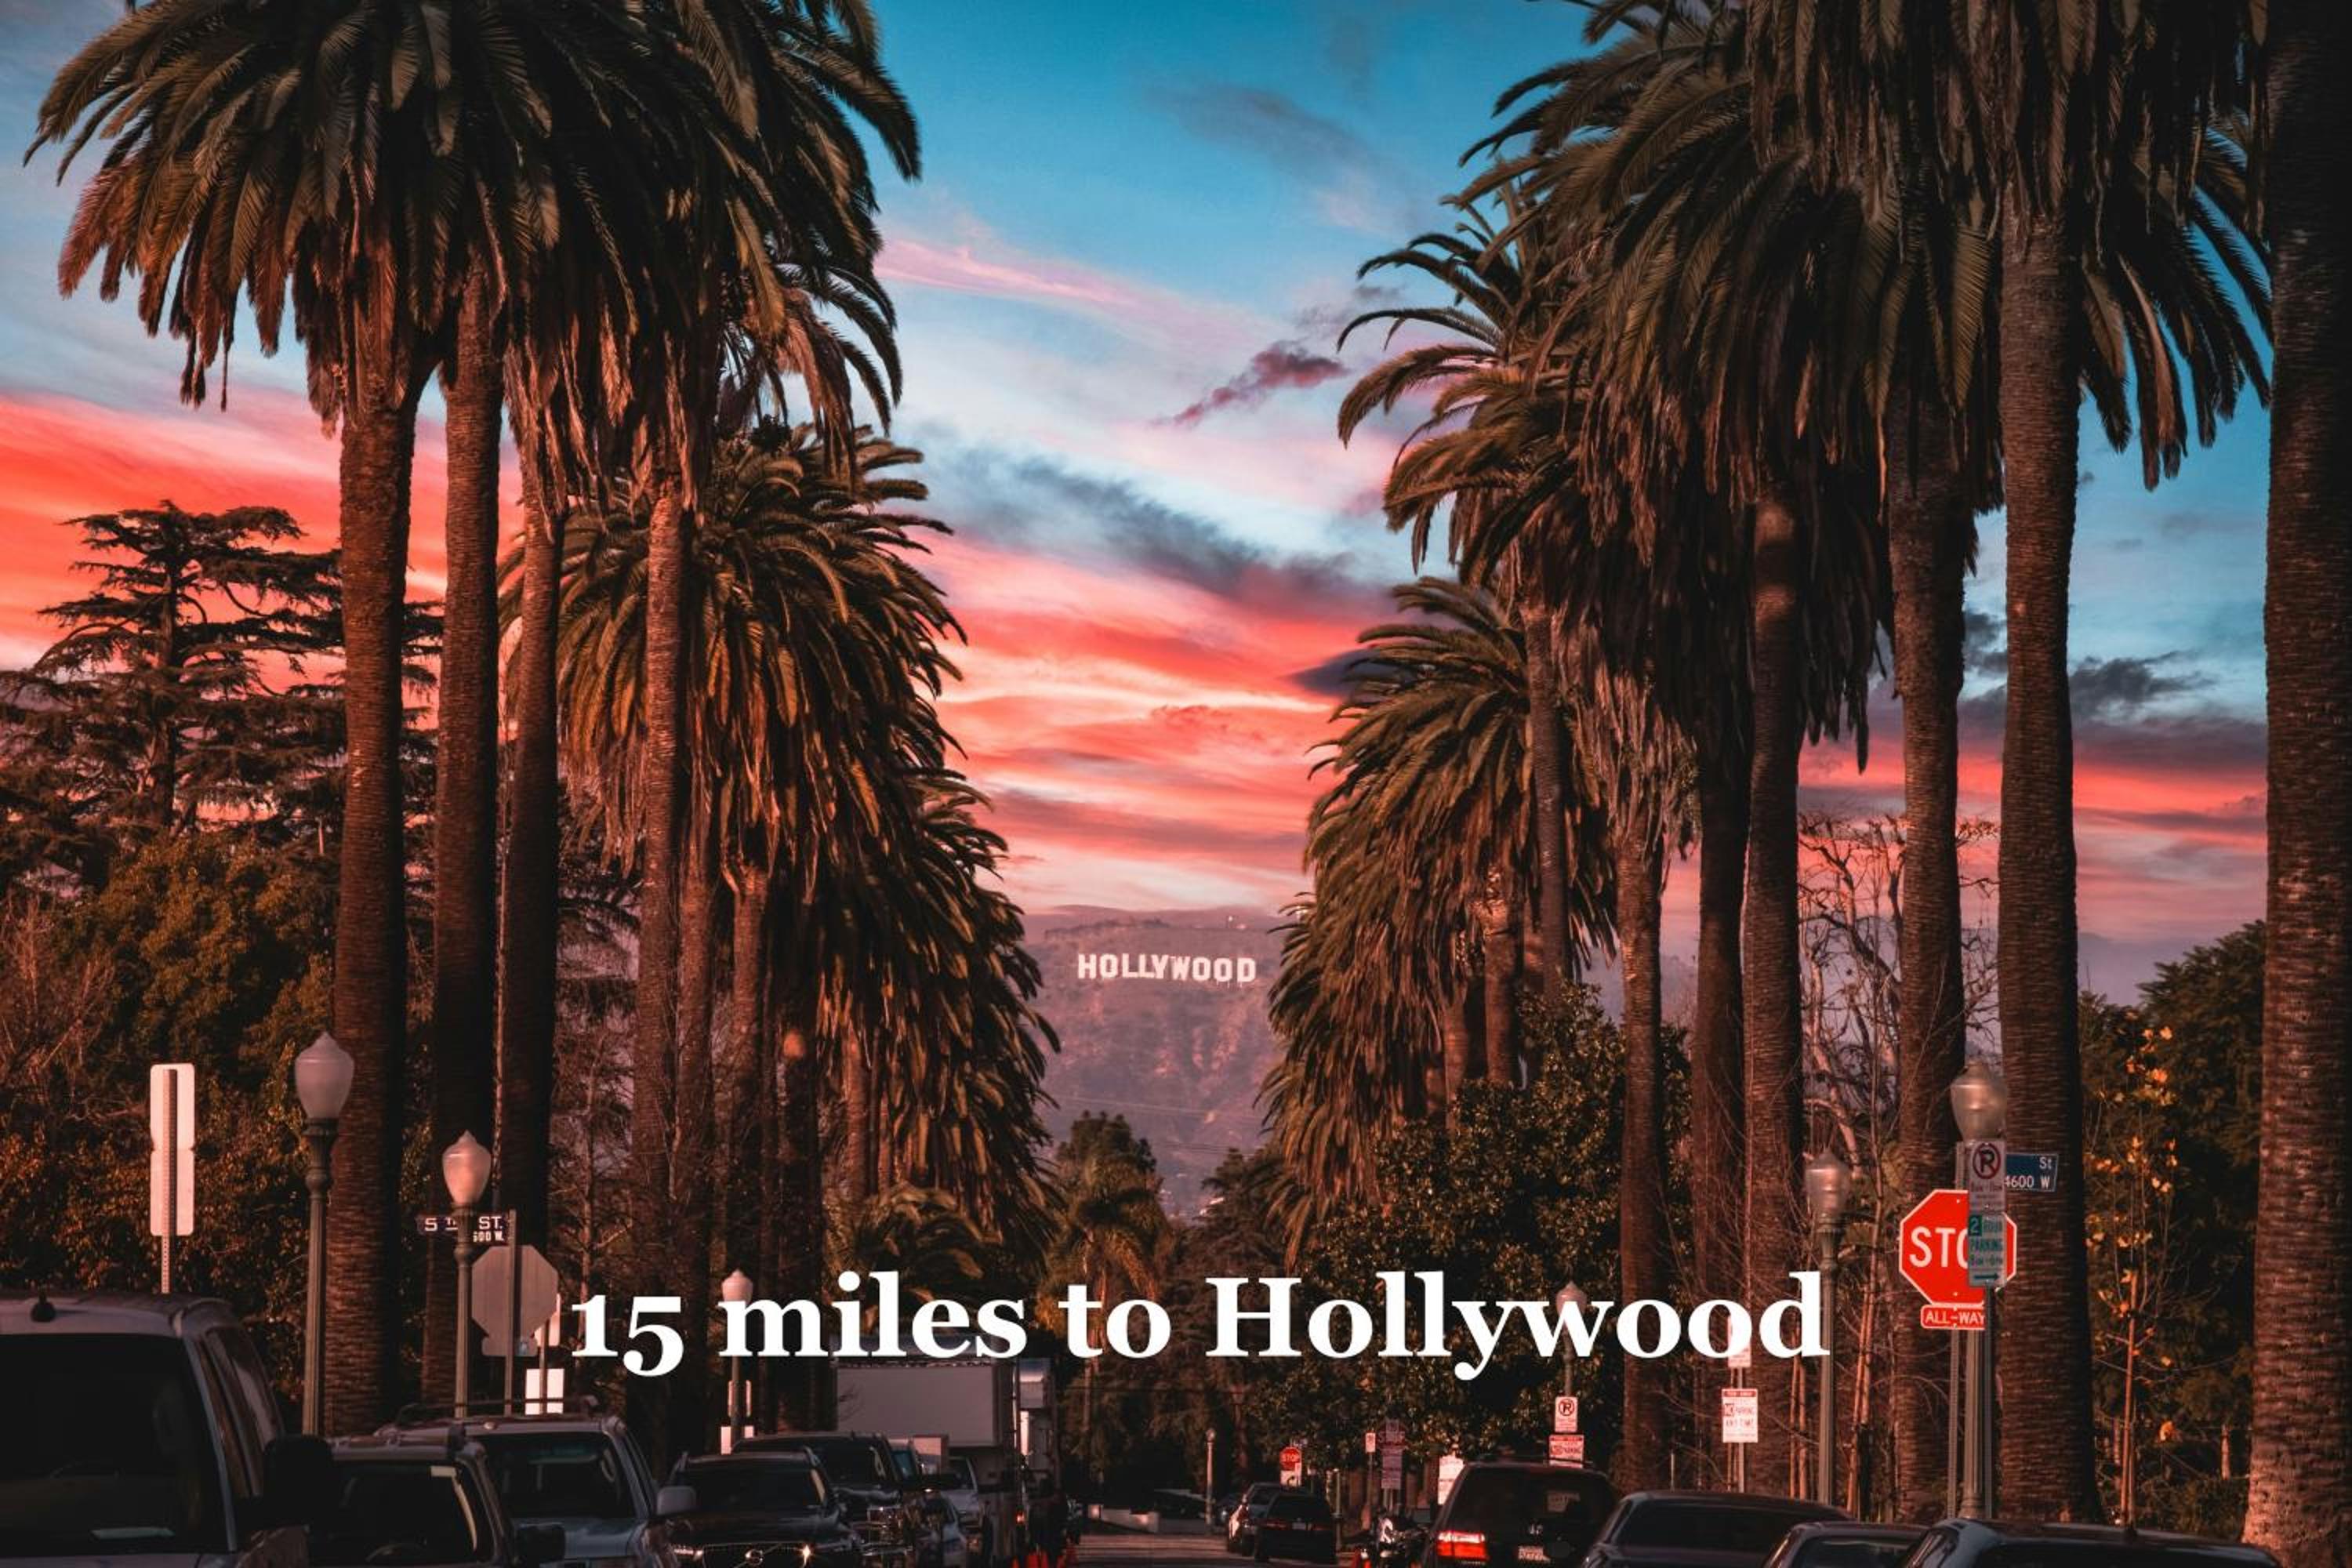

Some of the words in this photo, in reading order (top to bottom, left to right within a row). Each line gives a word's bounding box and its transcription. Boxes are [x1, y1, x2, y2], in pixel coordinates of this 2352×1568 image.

[1078, 953, 1256, 982] HOLLYWOOD
[2039, 1156, 2052, 1170] St
[2005, 1175, 2034, 1189] 4600
[2040, 1177, 2050, 1189] W
[1970, 1218, 1980, 1234] 2
[1925, 1310, 1985, 1324] ALL-WAY
